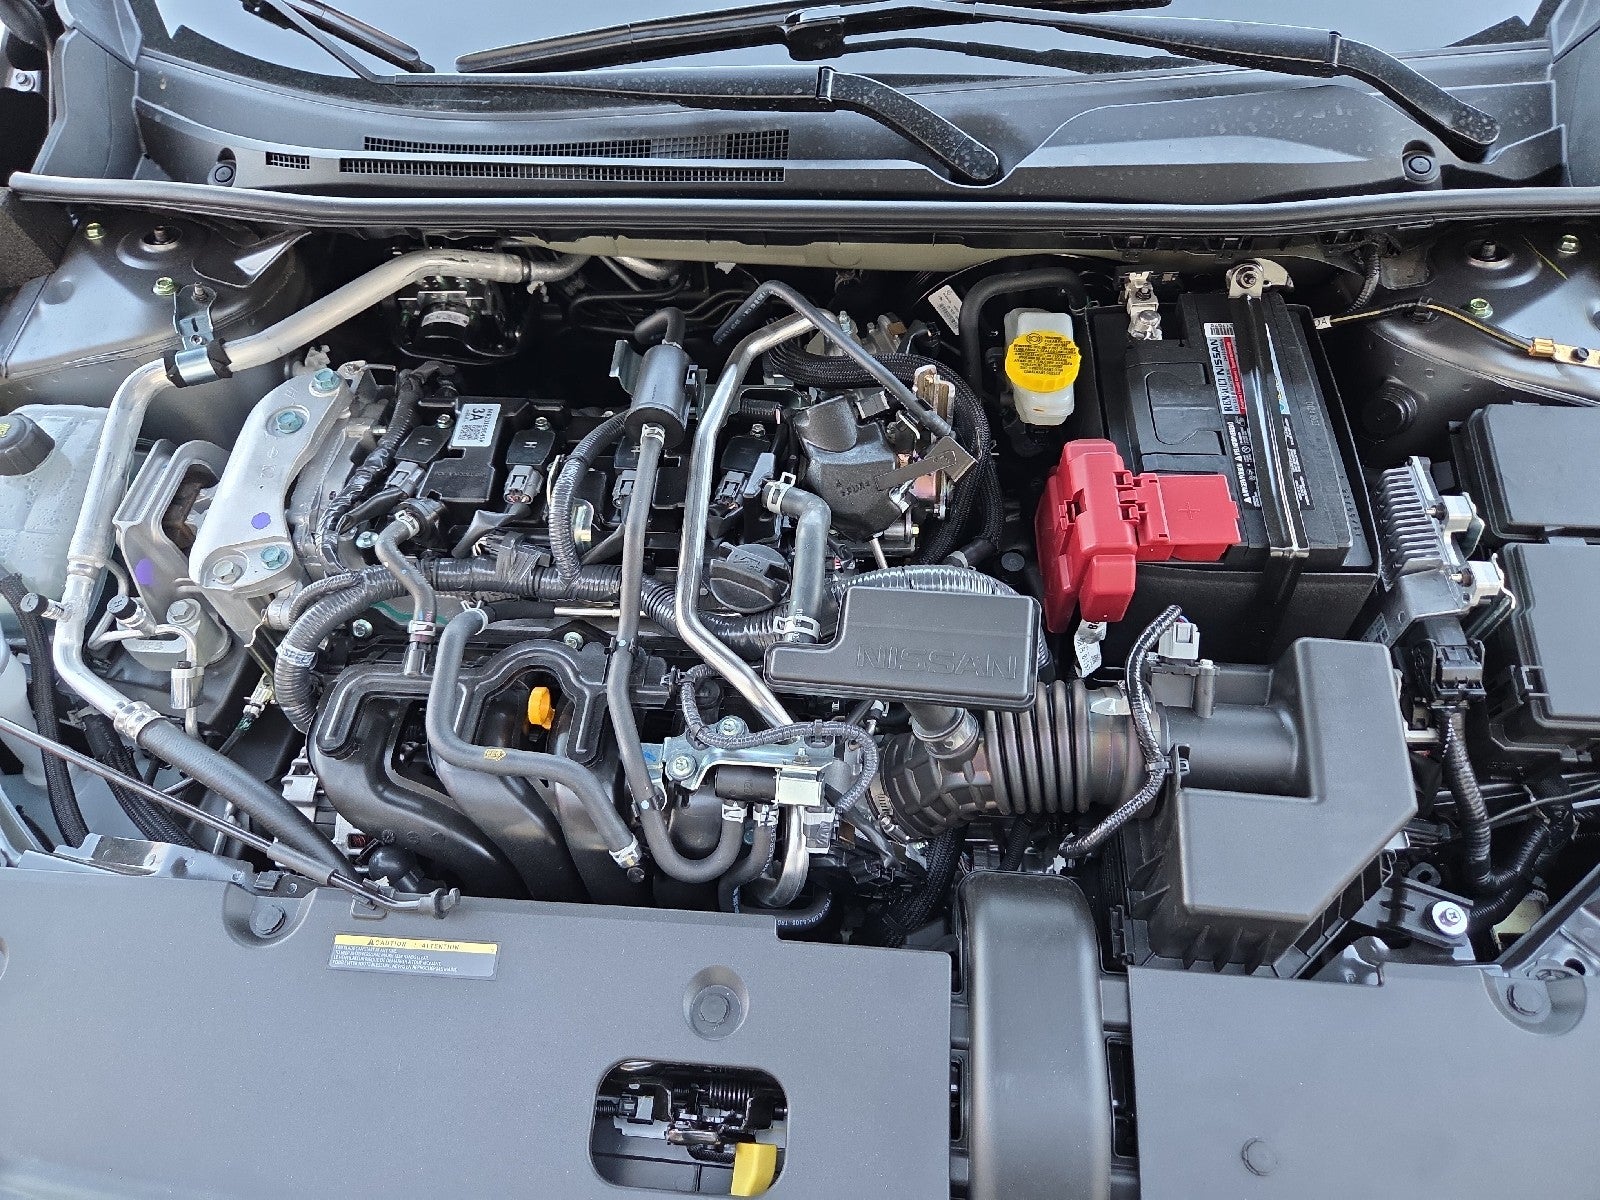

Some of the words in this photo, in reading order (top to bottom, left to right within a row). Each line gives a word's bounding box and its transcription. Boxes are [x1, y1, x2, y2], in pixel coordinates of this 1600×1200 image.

[1209, 338, 1226, 373] NISSAN
[1216, 376, 1234, 413] RENAULT
[469, 407, 486, 422] 3A
[856, 645, 1017, 679] NISSAN
[375, 939, 407, 948] CAUTION
